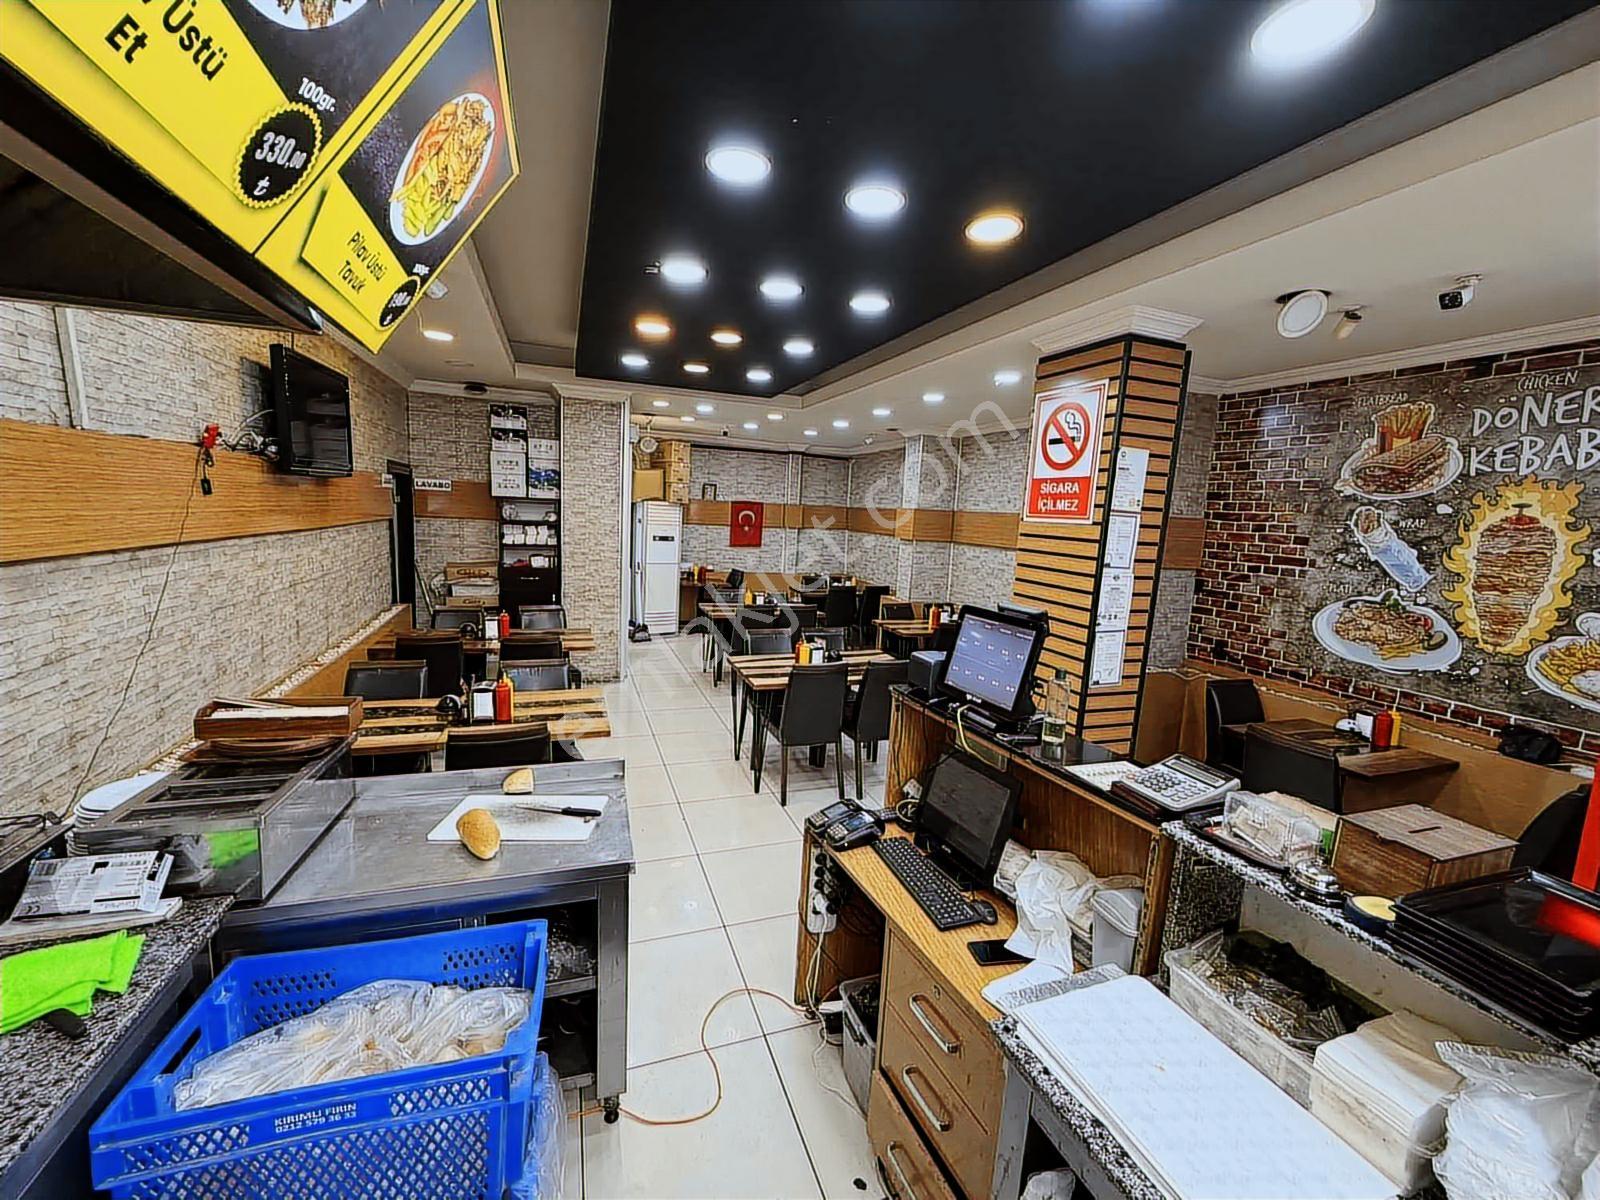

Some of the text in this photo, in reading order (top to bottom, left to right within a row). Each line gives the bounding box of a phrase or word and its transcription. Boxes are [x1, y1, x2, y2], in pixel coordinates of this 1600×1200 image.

[104, 13, 148, 64] Et
[162, 0, 228, 81] Üstü
[298, 77, 336, 112] 100gr.
[255, 131, 307, 169] 330,00
[1517, 371, 1578, 392] CHICKEN
[415, 480, 451, 489] LAVABO
[1040, 480, 1079, 494] SİGARA
[1038, 496, 1078, 513] İÇİLMEZ
[1398, 518, 1427, 529] WRAP
